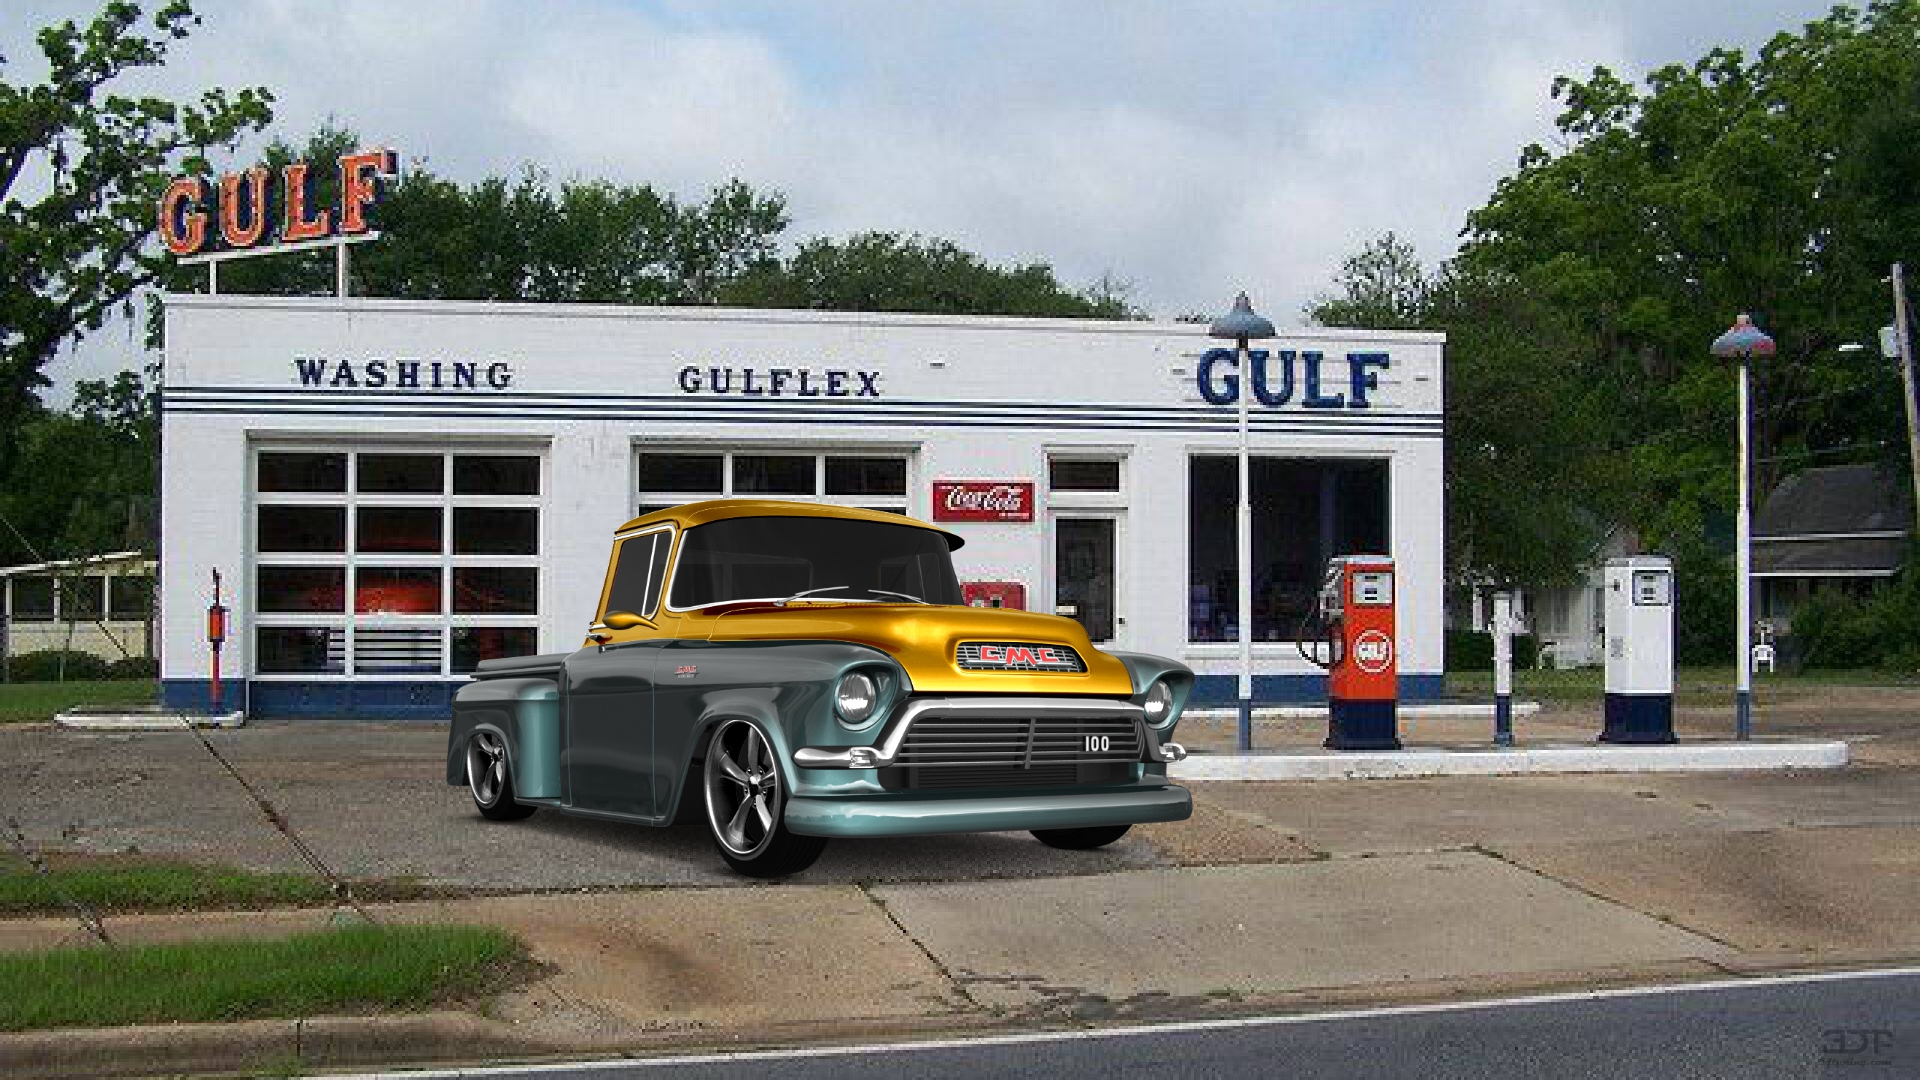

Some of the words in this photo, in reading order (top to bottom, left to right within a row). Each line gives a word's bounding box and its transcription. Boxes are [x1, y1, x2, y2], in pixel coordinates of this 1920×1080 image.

[156, 150, 396, 252] GULF
[295, 359, 513, 389] WASHING
[679, 366, 880, 396] GULFLEX
[1197, 348, 1390, 408] GULF
[980, 645, 1060, 666] GMC
[1085, 735, 1110, 752] 100
